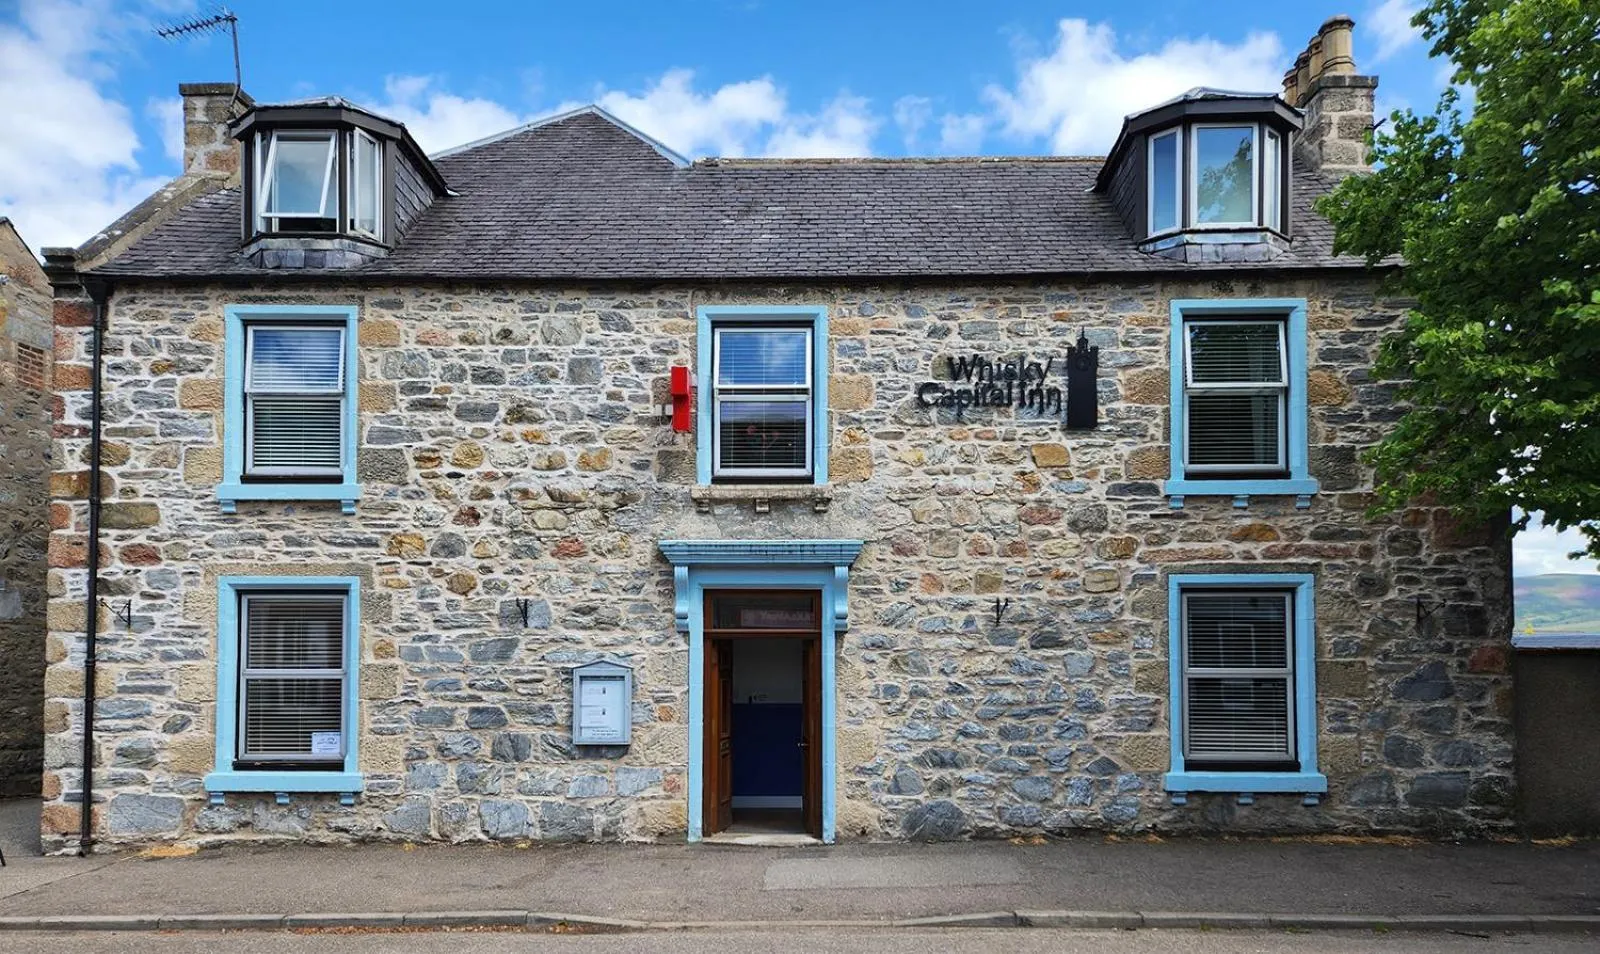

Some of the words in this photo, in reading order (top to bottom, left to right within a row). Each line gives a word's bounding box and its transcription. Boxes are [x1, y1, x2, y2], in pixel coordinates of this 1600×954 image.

[947, 354, 1054, 385] Whisky
[918, 381, 1014, 416] Capital
[1019, 381, 1062, 411] Inn
